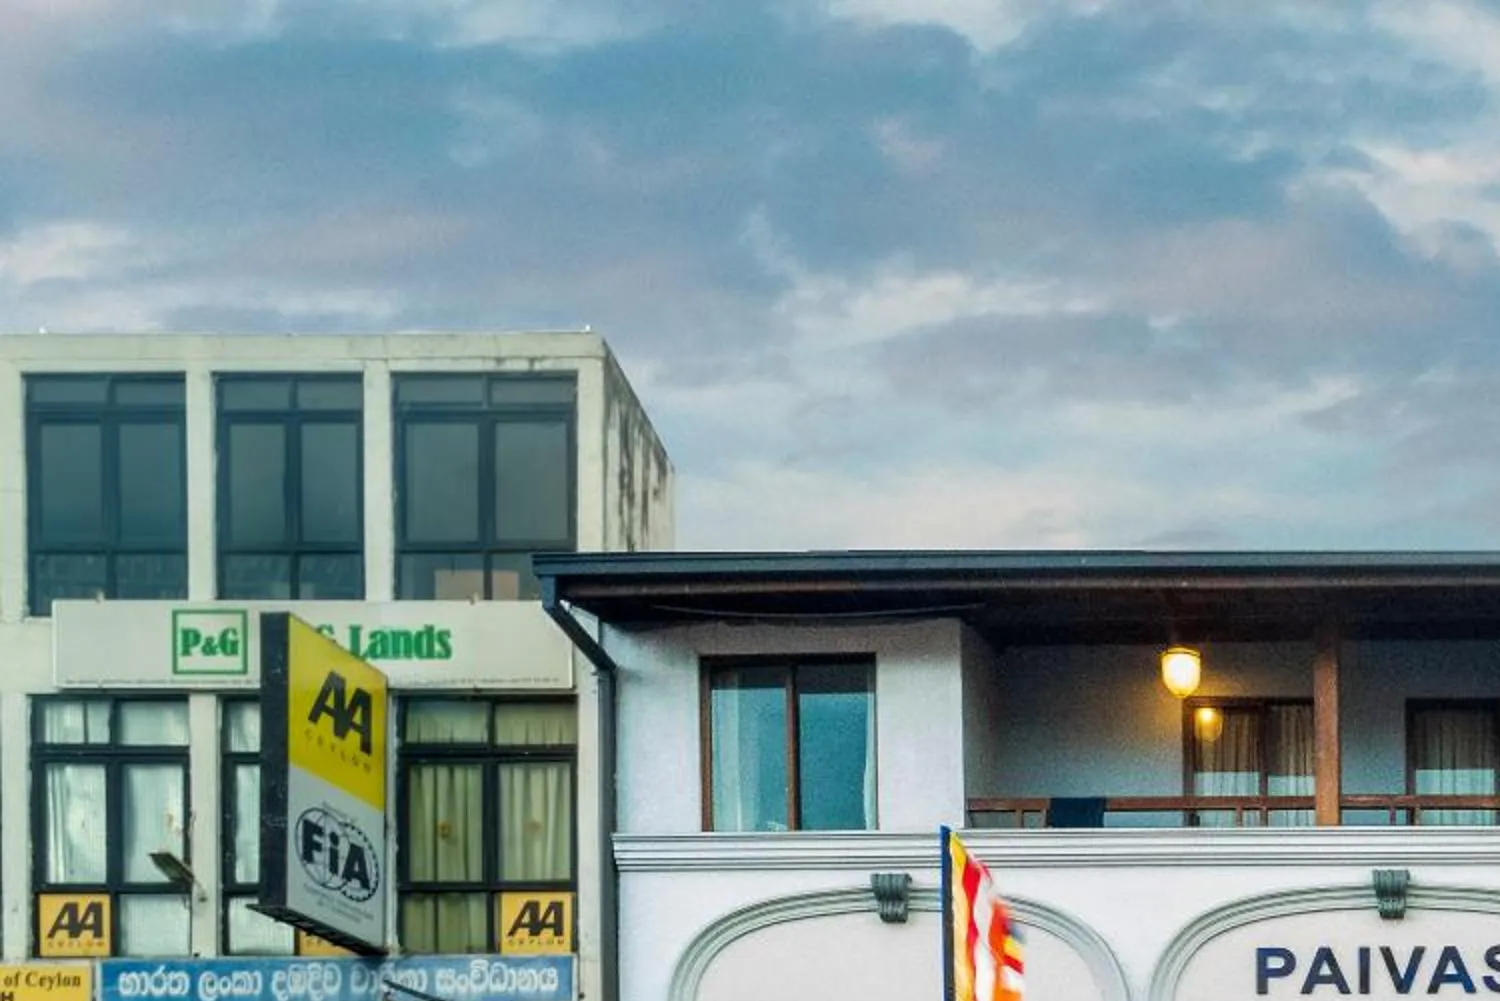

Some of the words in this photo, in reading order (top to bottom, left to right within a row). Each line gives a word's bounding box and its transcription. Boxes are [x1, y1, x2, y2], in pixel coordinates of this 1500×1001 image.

[181, 627, 239, 656] P&G
[348, 624, 452, 659] Lands
[308, 670, 372, 757] AA
[47, 901, 104, 939] AA
[507, 900, 564, 937] AA
[4, 971, 20, 987] of
[25, 971, 81, 991] Ceylon
